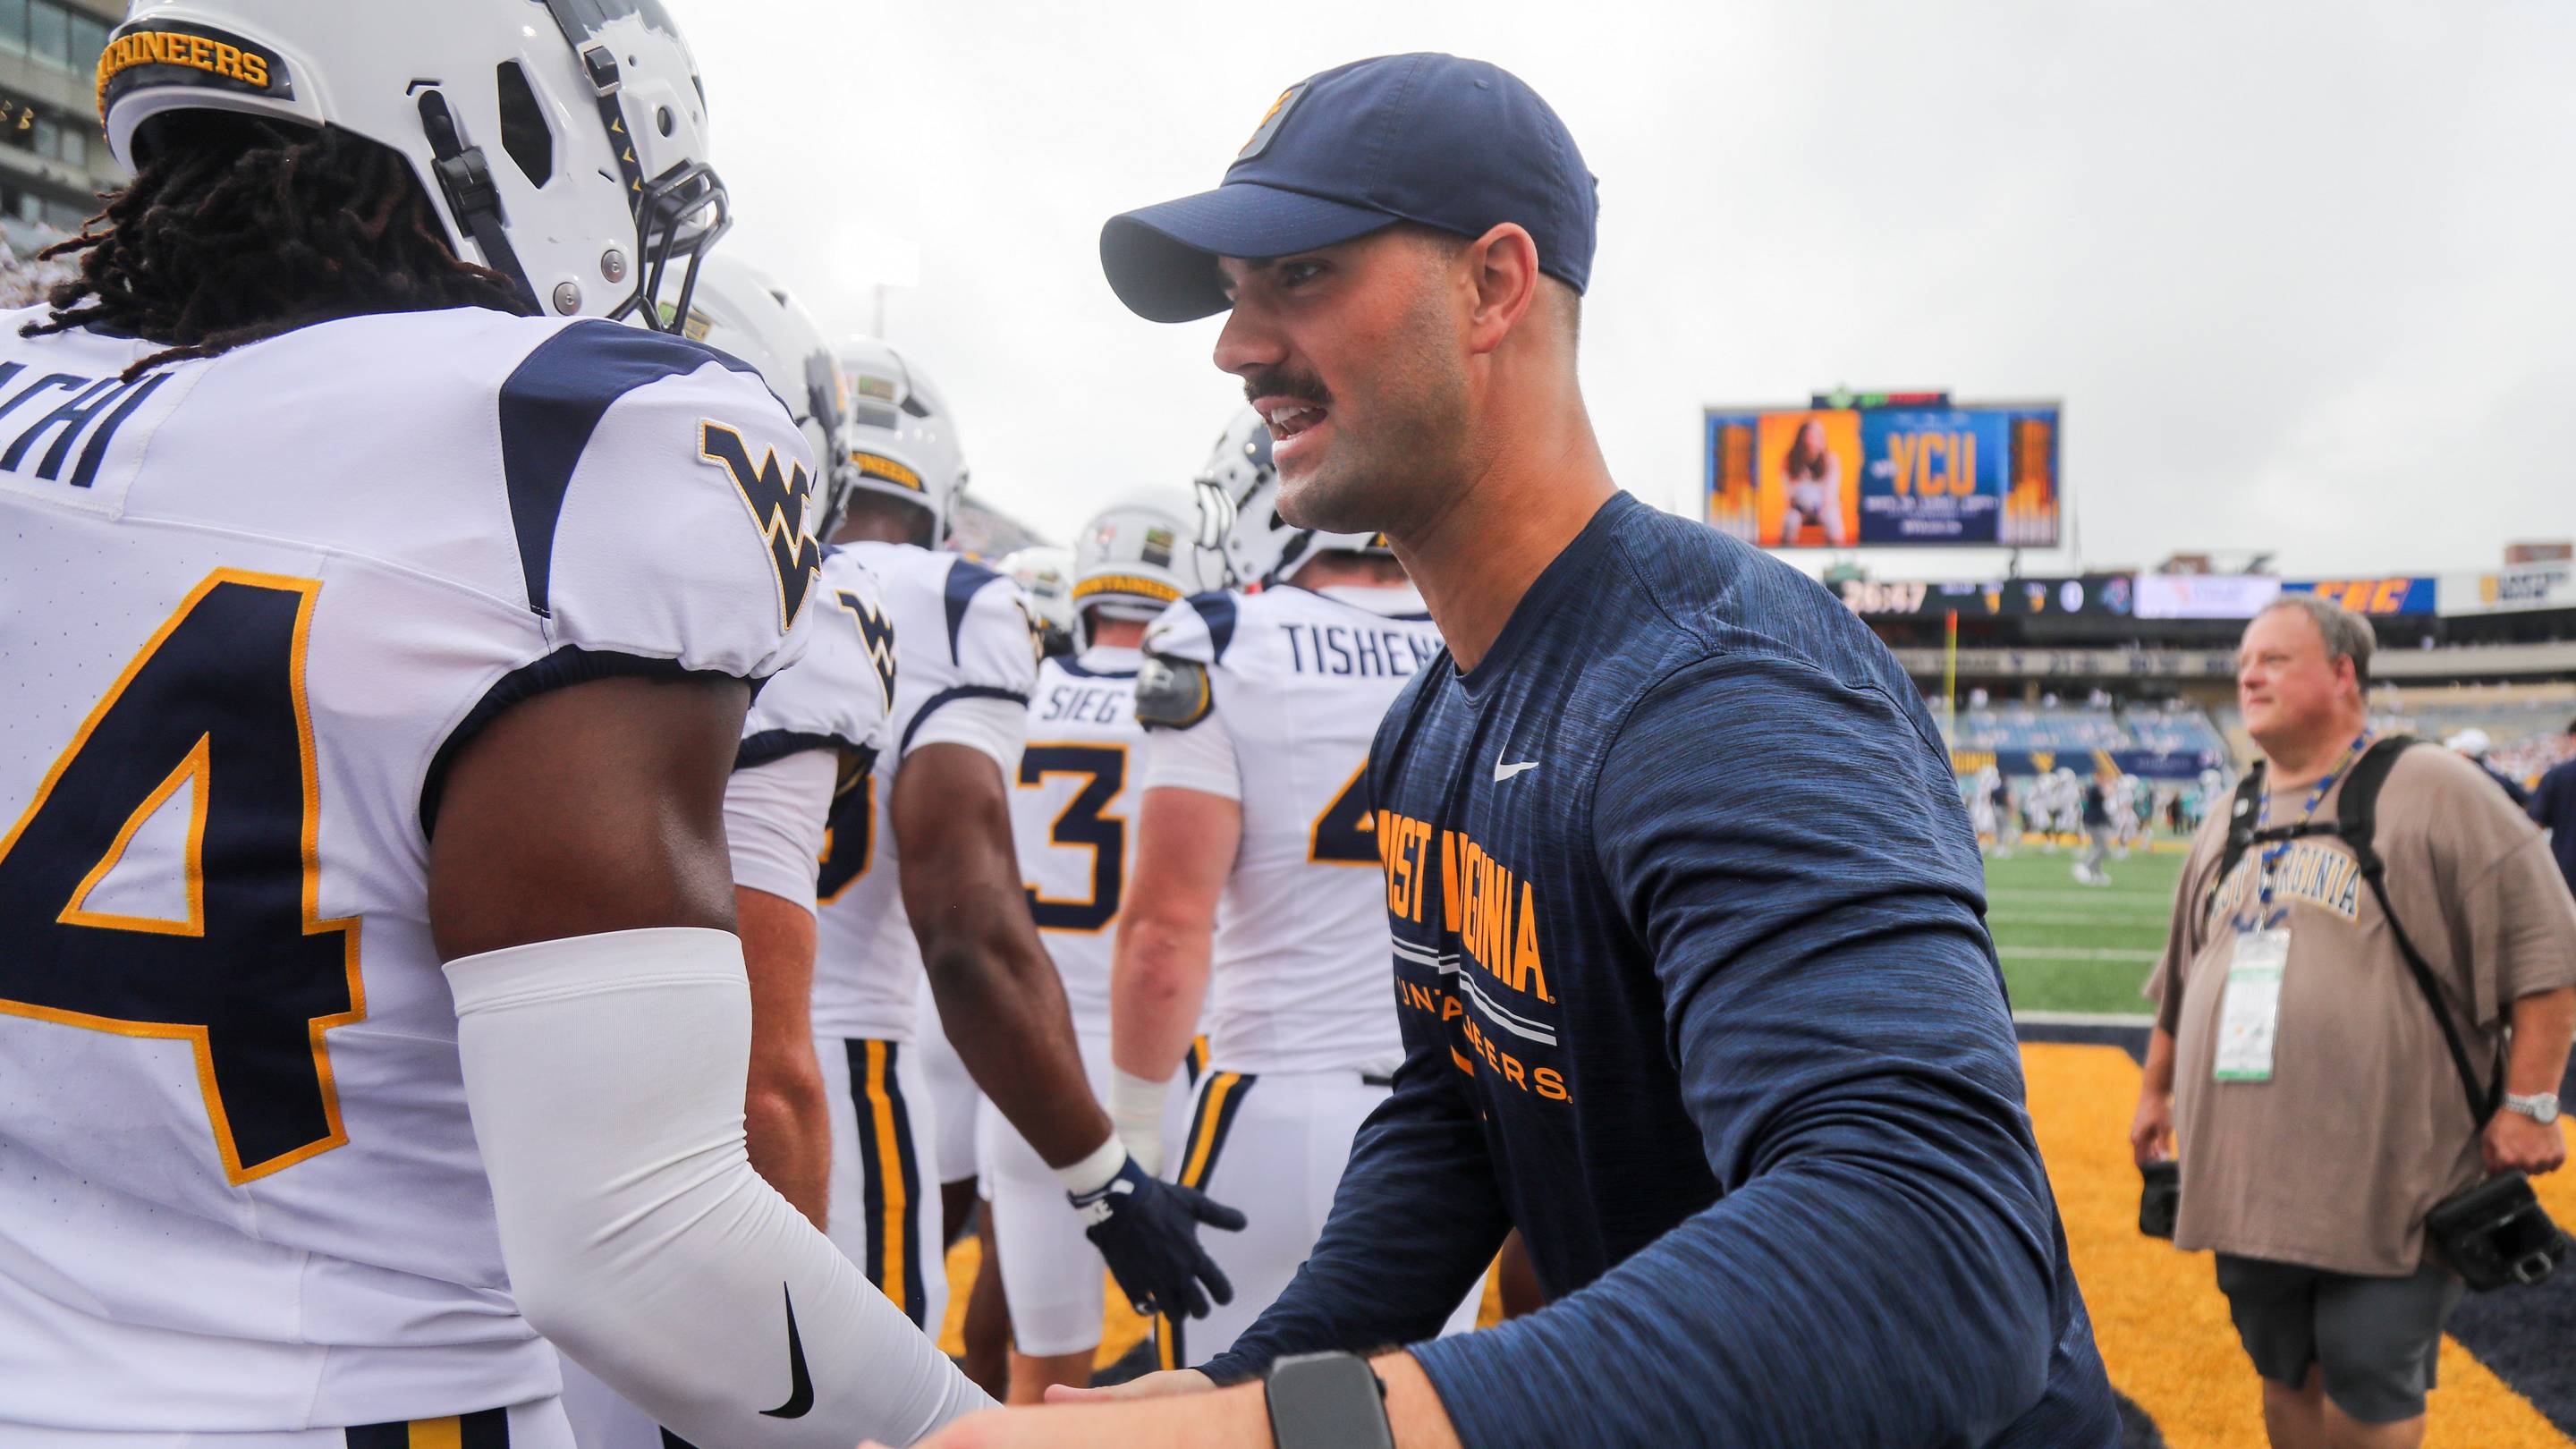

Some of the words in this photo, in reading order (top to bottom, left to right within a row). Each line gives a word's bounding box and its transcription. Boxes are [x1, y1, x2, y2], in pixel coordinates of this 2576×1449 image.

[1889, 431, 1977, 498] VCU
[1280, 623, 1445, 676] TISHEN
[1041, 684, 1127, 724] SIEG
[1017, 741, 1129, 936] 3
[0, 566, 367, 1187] 4
